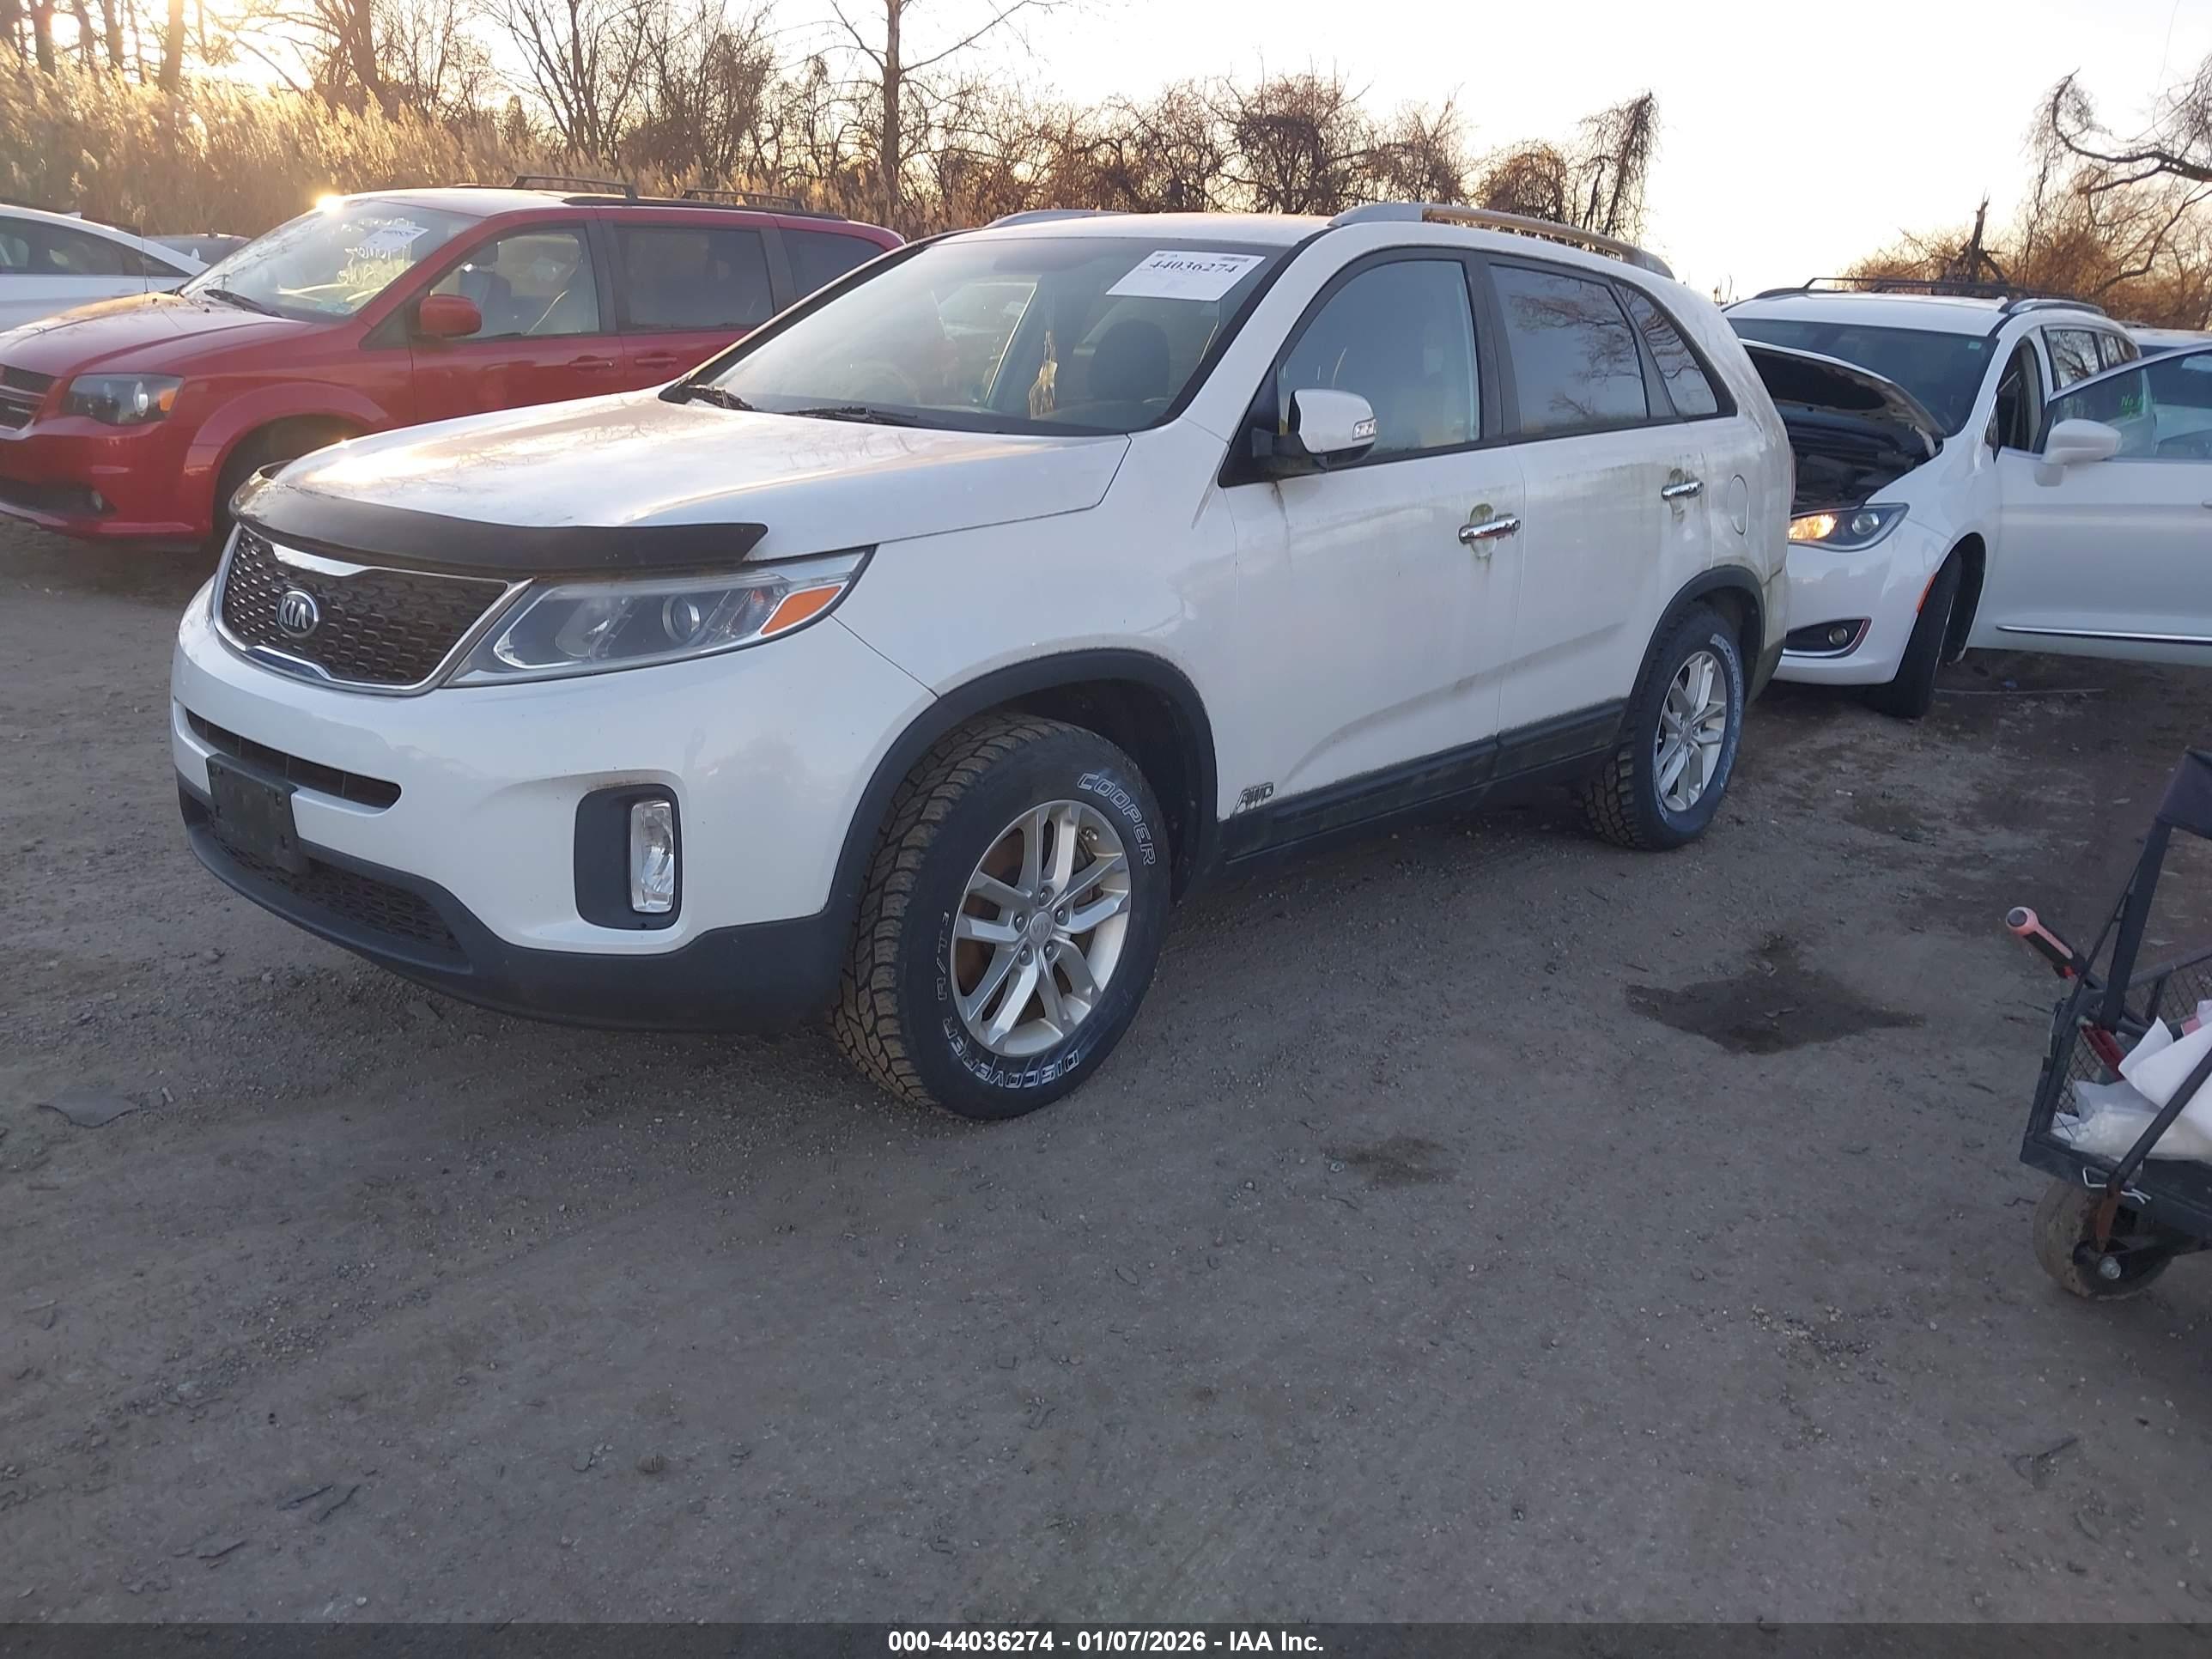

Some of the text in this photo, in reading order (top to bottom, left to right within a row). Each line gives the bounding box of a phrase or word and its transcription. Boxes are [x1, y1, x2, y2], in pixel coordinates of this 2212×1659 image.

[1150, 259, 1238, 274] 44036274
[1077, 772, 1157, 866] COOPER
[1236, 781, 1274, 811] AWD
[943, 1015, 1080, 1089] DISCOVERER
